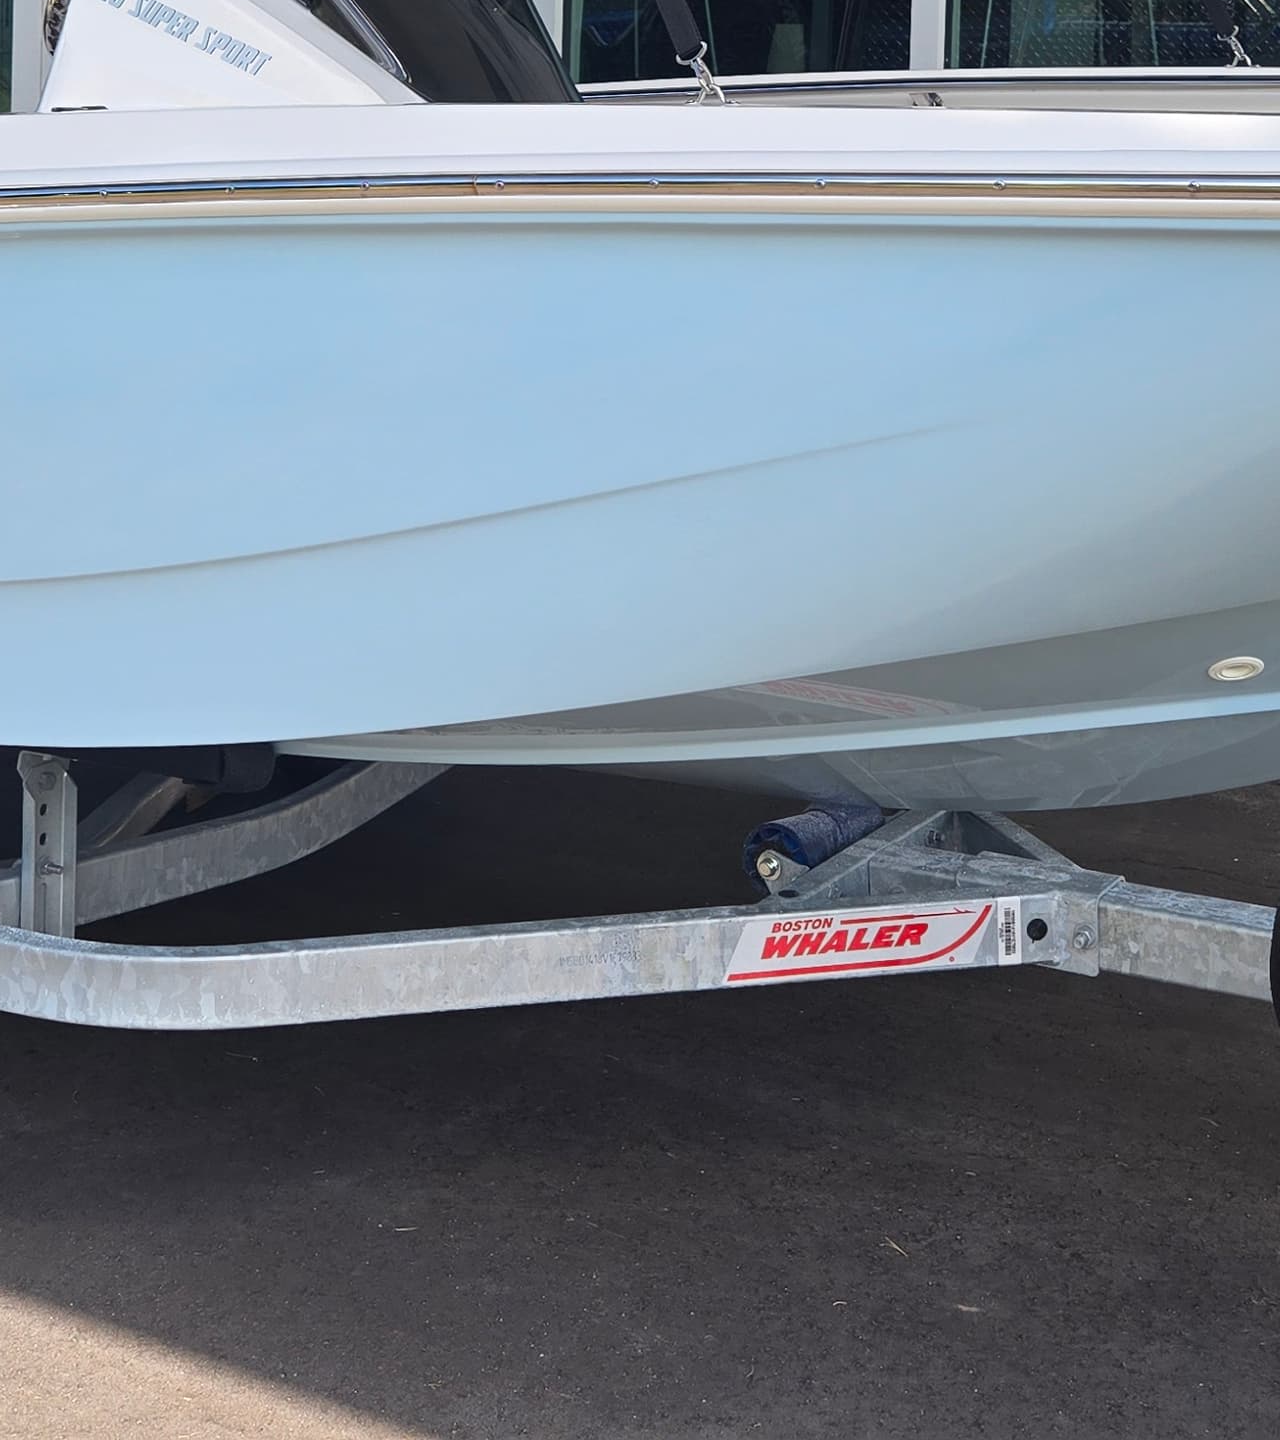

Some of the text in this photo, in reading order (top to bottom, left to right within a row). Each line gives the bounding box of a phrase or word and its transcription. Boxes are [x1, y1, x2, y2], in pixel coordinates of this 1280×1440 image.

[194, 26, 272, 77] SPORT
[761, 923, 929, 960] WHALER
[772, 917, 834, 934] BOSTON
